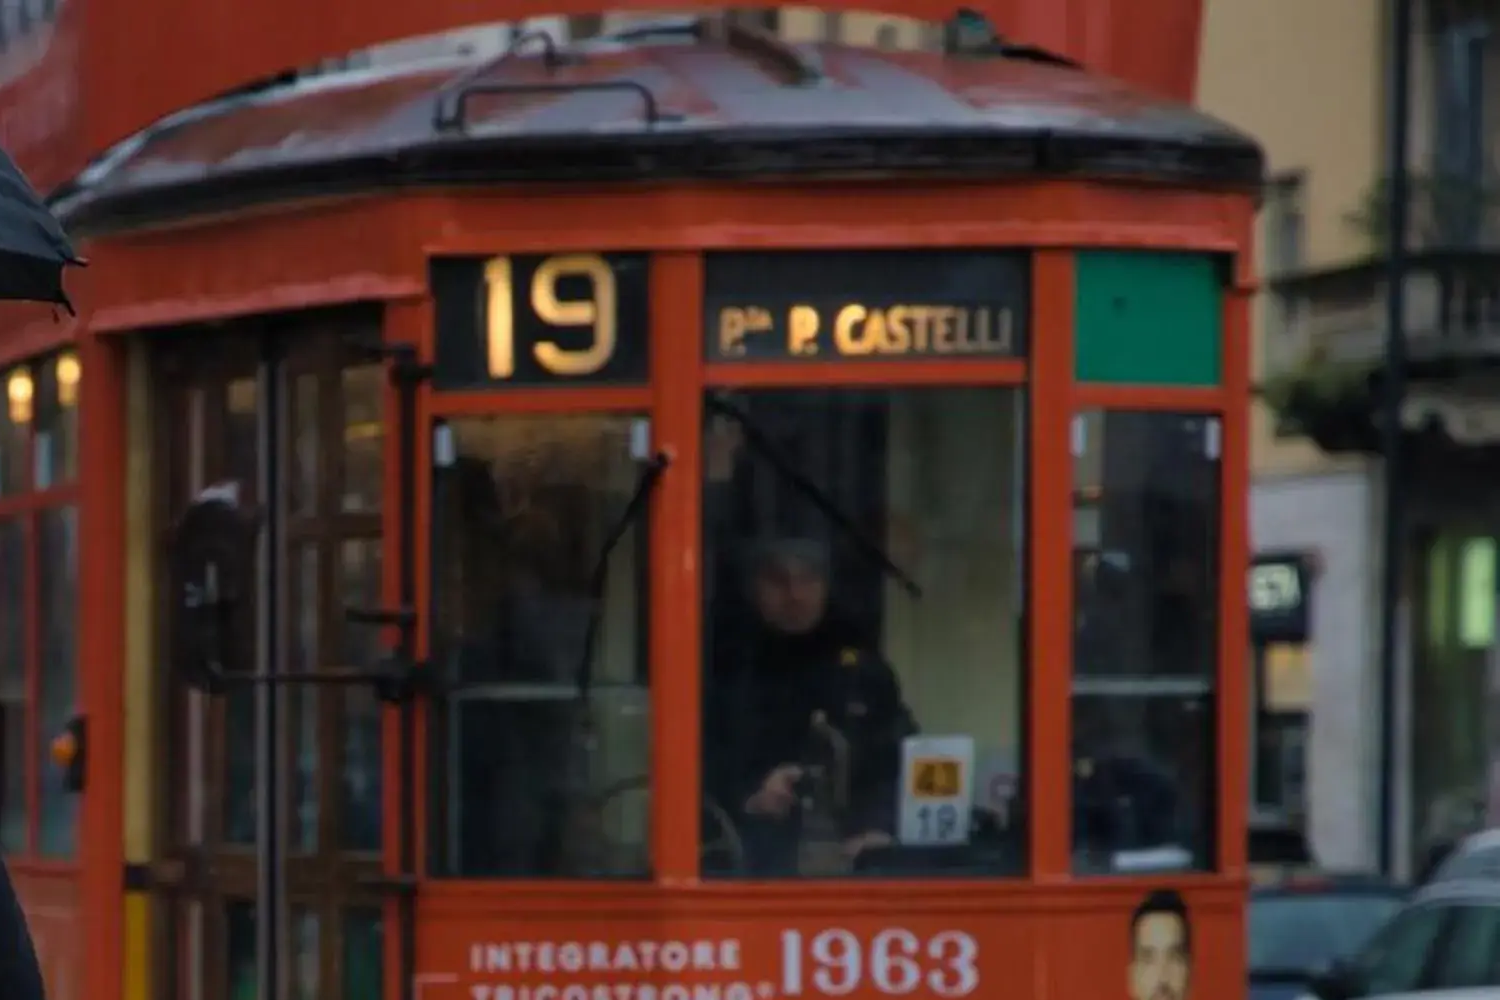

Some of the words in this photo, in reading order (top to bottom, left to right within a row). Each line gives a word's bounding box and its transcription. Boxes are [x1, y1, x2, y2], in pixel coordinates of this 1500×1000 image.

[484, 255, 618, 379] 19
[834, 303, 1013, 355] CASTELLI
[469, 939, 742, 972] INTEGRATORE
[780, 928, 980, 998] 1963
